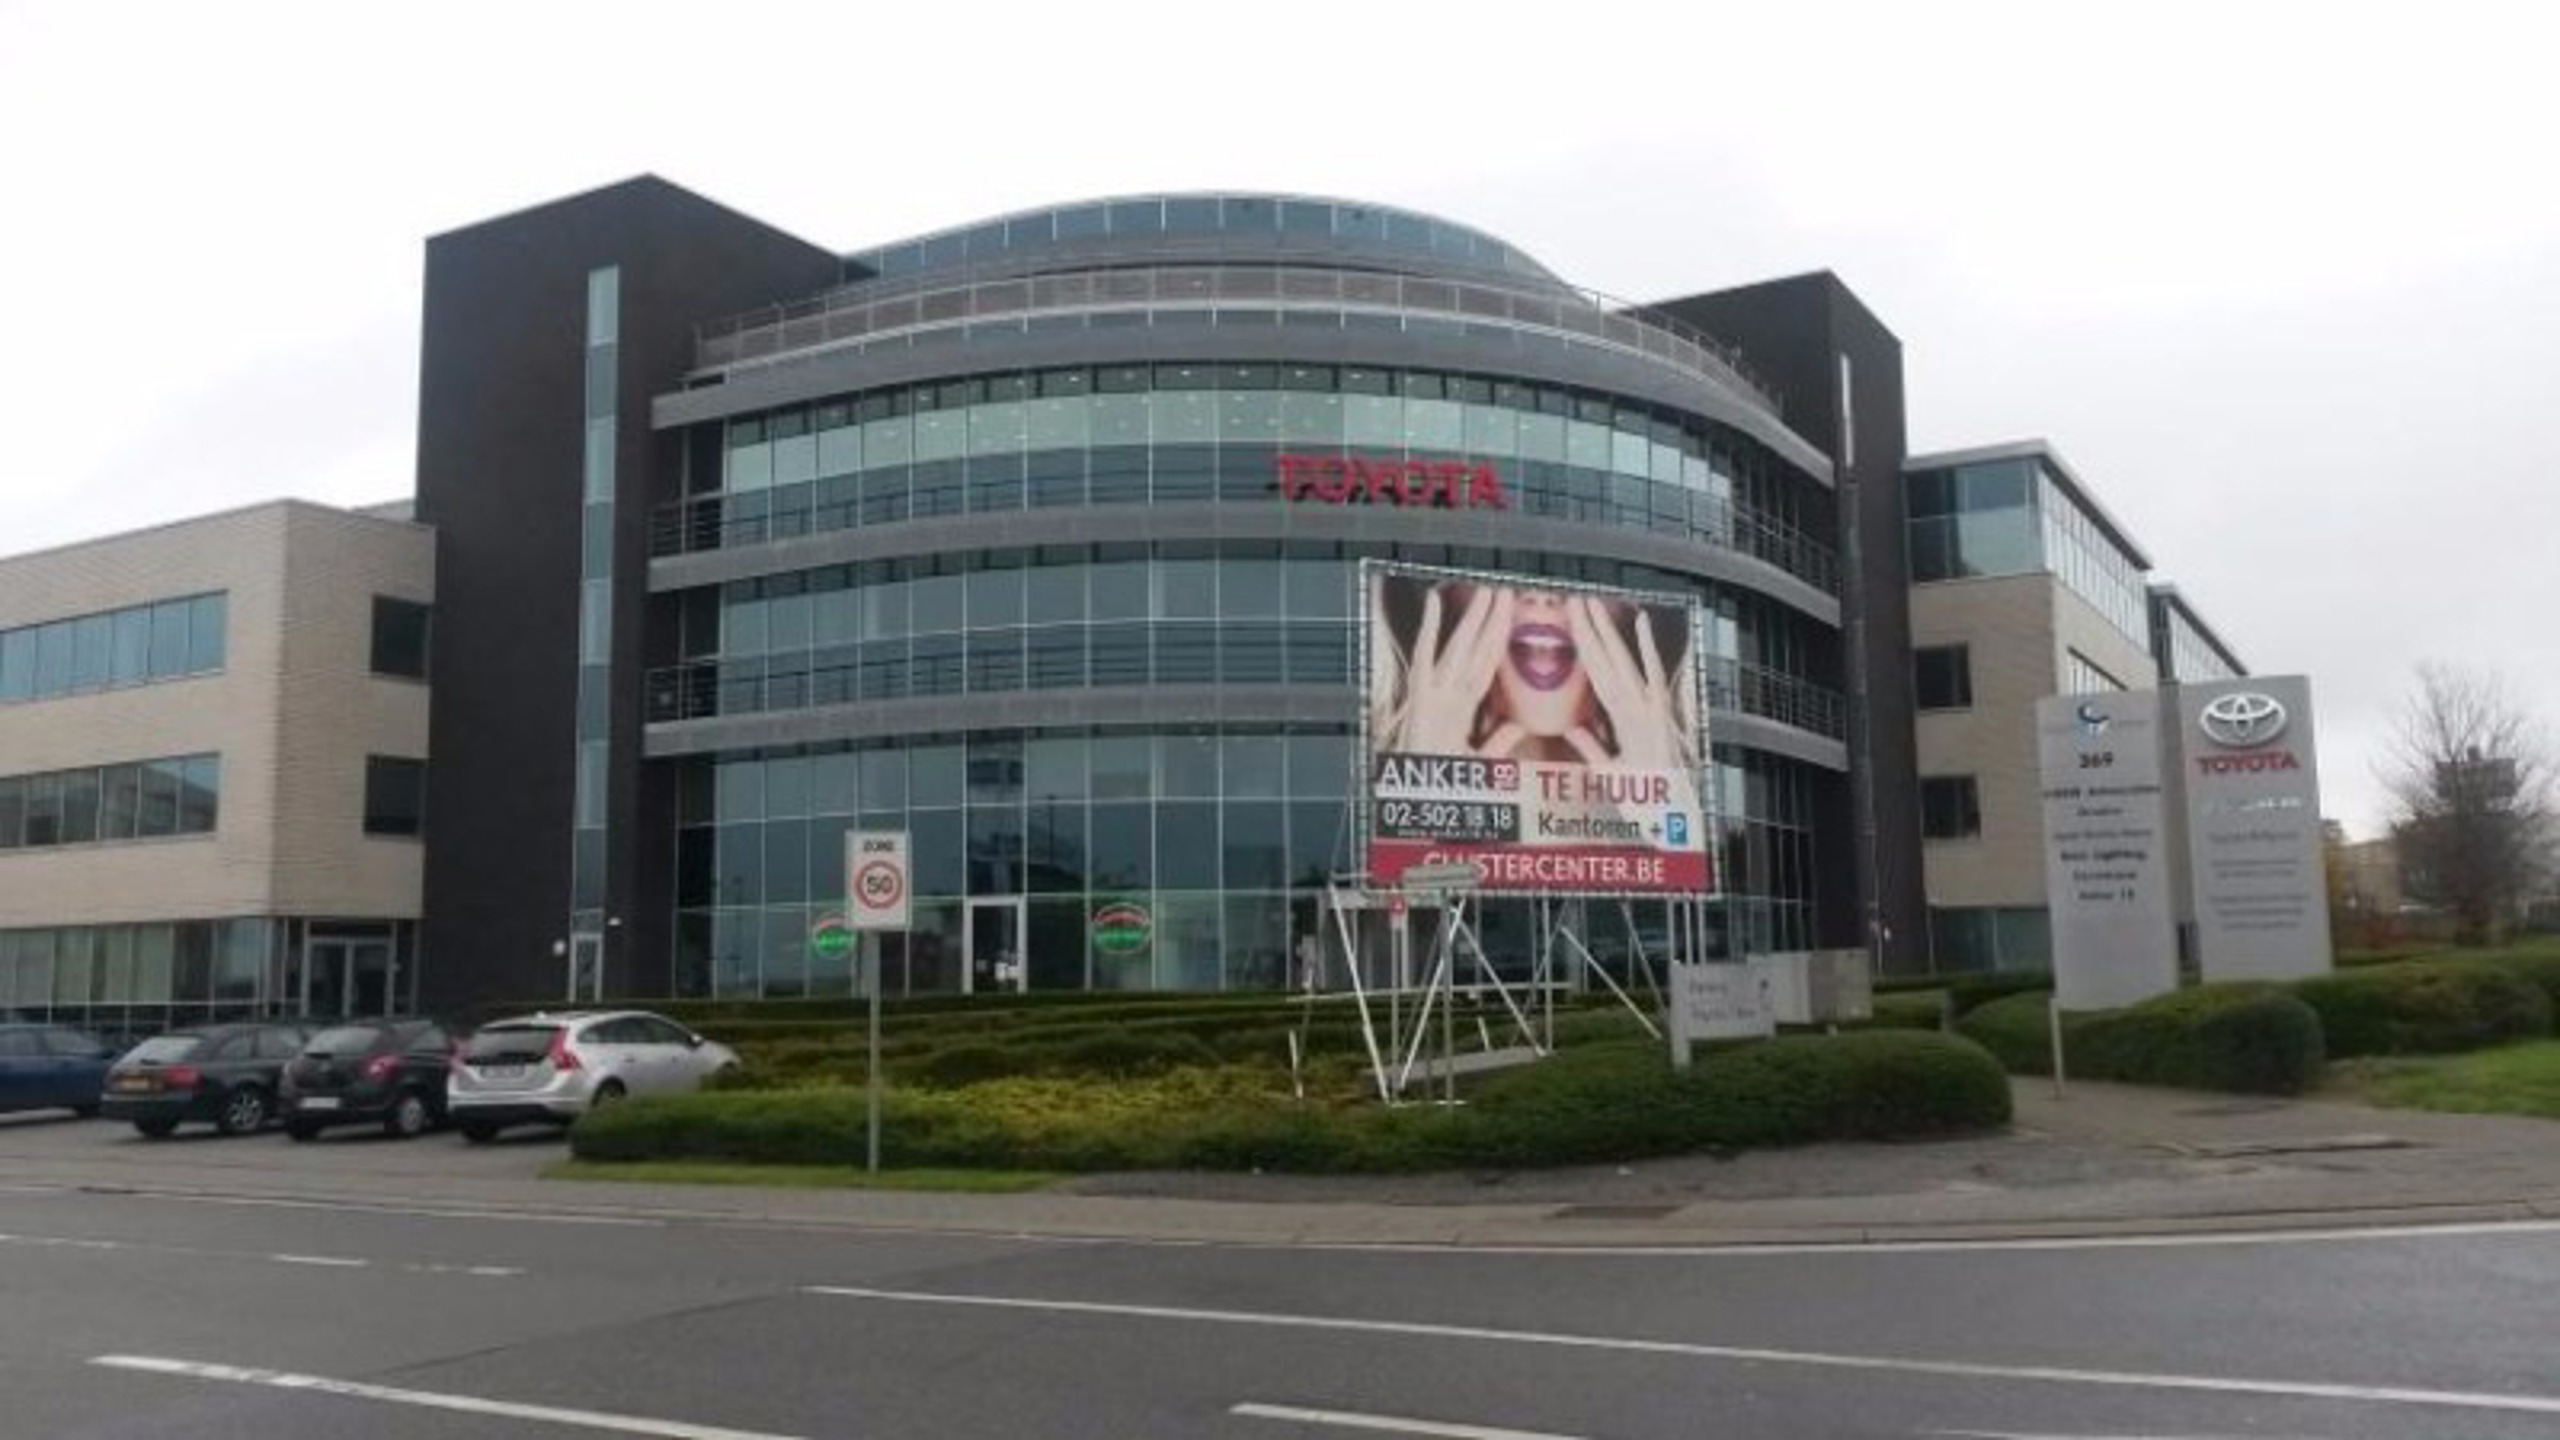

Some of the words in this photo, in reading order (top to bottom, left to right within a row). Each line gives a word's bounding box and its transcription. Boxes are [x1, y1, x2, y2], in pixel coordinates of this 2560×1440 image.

[1280, 455, 1504, 510] TOYOTA
[1379, 756, 1487, 792] ANKER
[2197, 751, 2299, 775] TOYOTA
[1536, 770, 1572, 802] TE
[1582, 773, 1671, 805] HUUR
[1383, 802, 1460, 828] 02-502
[1537, 811, 1640, 838] Kantoren
[867, 874, 894, 895] 50
